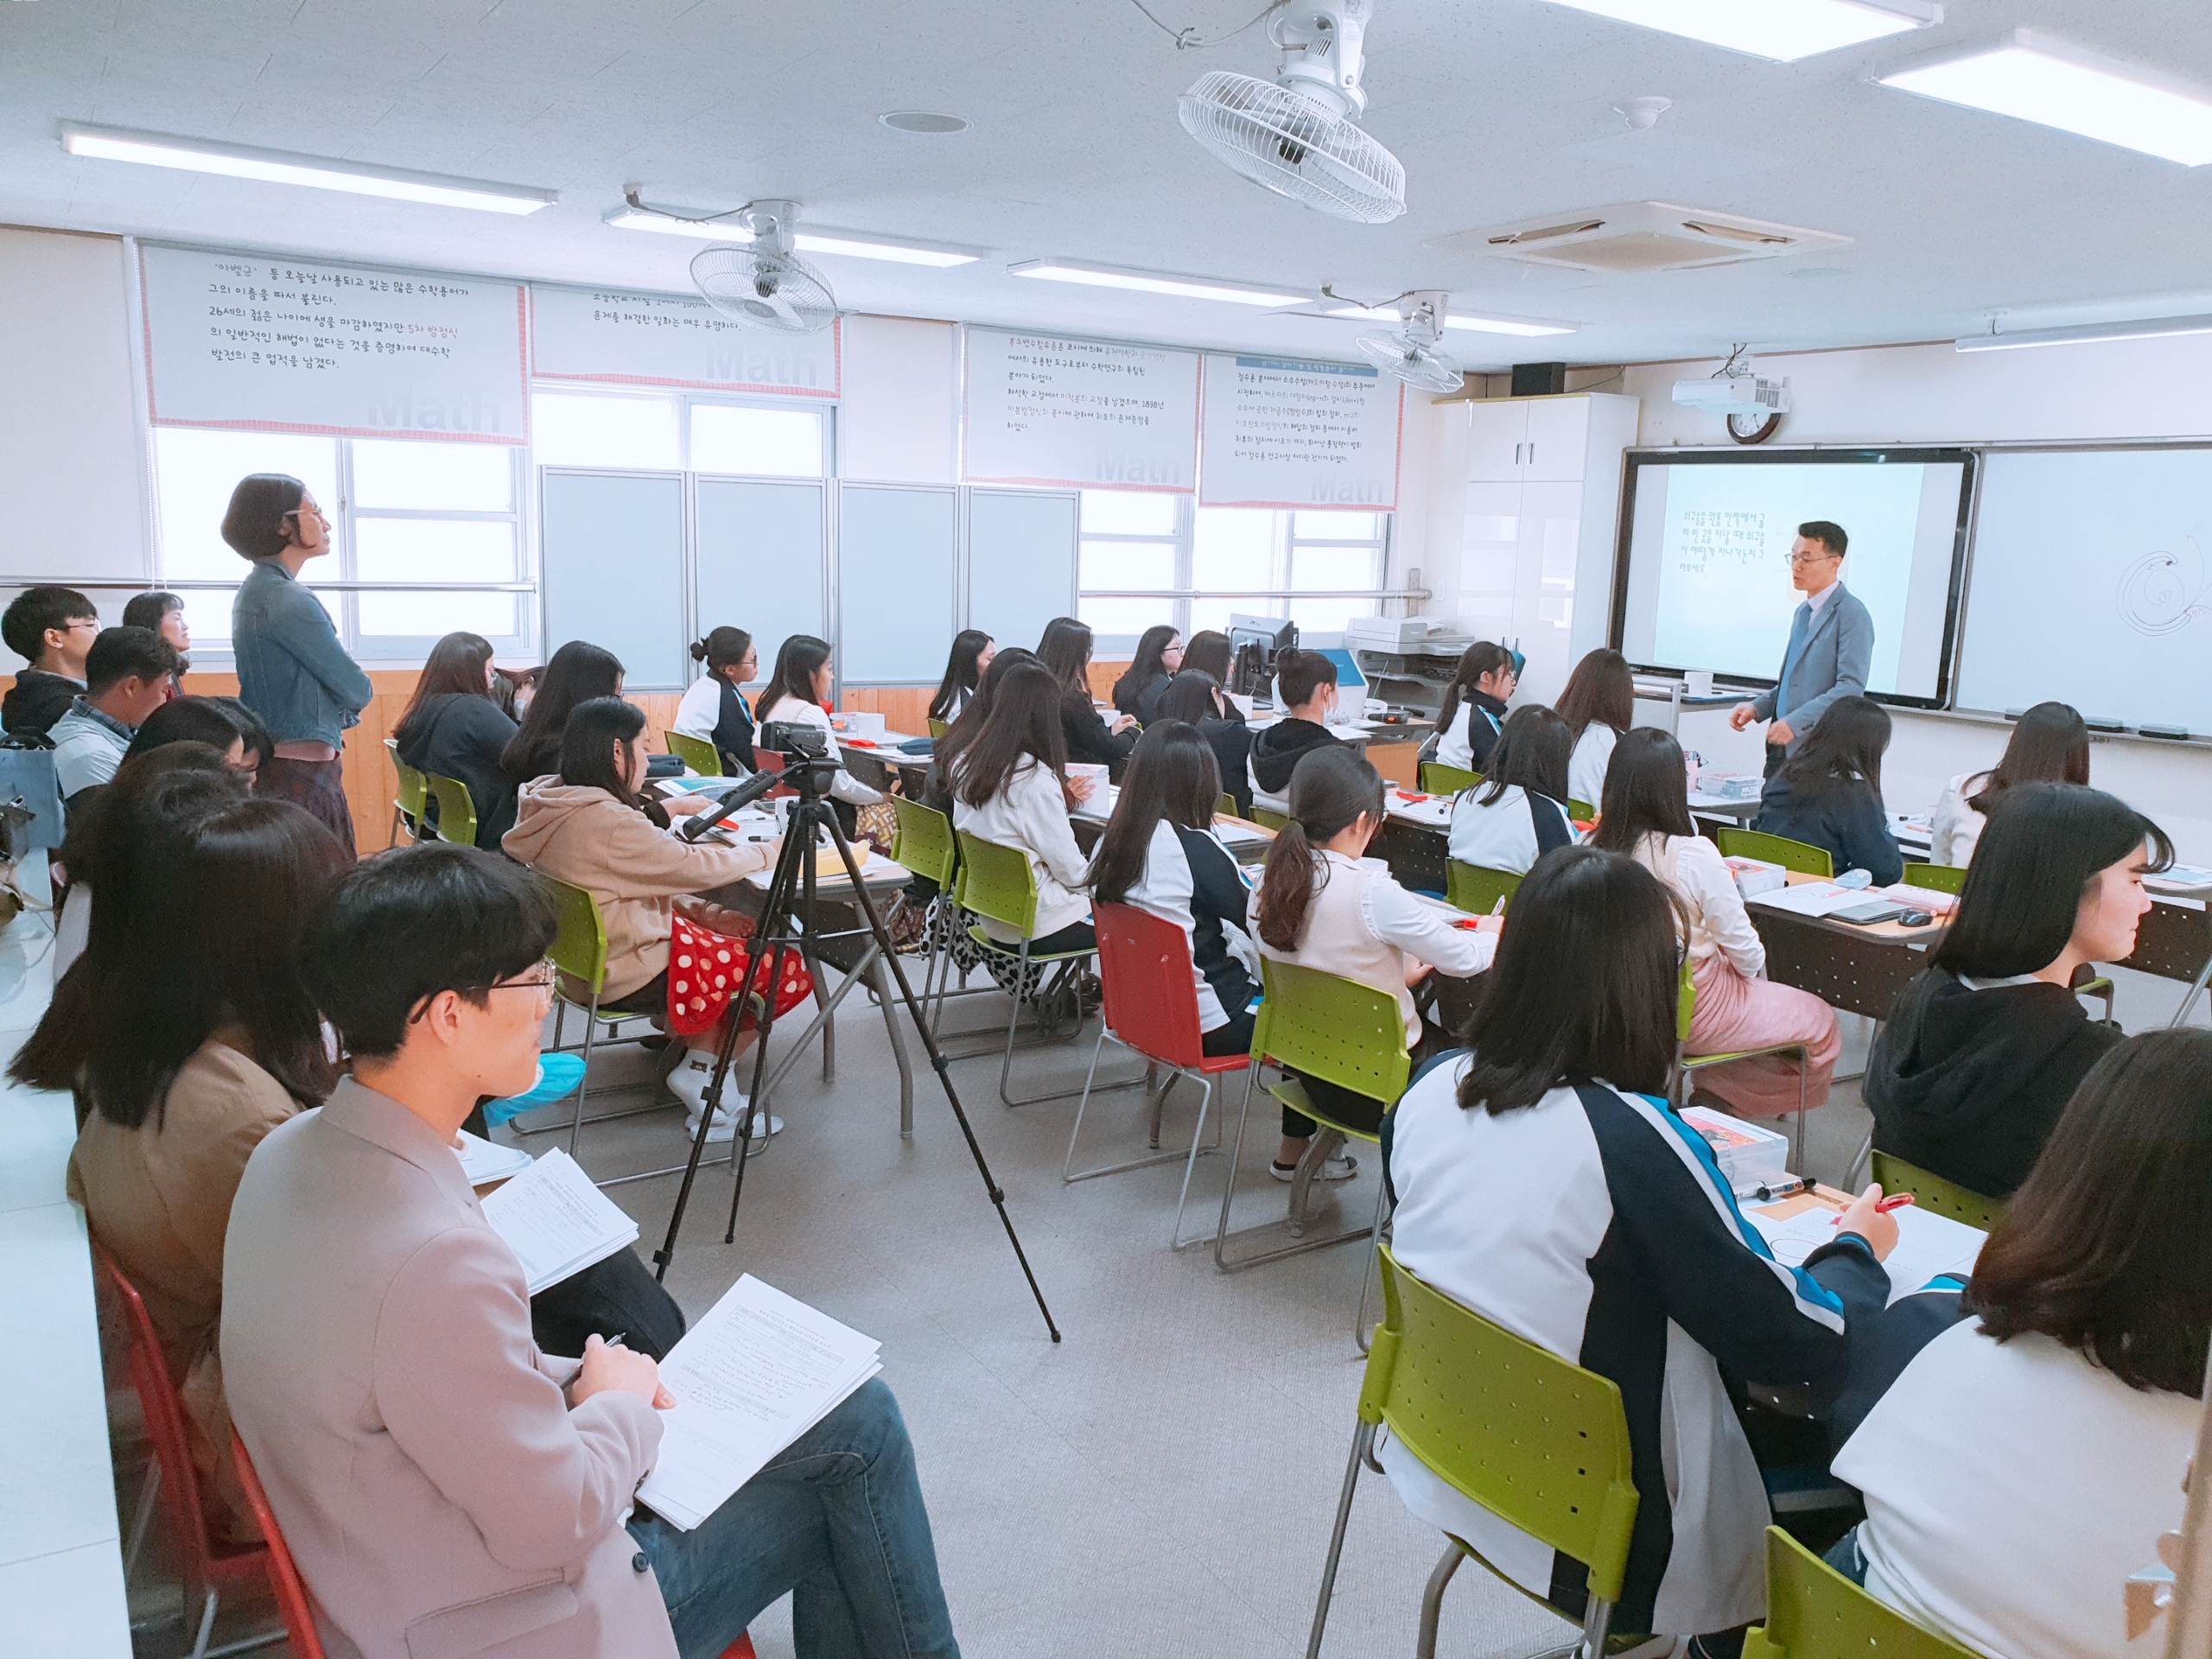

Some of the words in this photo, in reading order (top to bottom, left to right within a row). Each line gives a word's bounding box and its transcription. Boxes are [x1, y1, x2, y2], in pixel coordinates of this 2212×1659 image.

[270, 269, 279, 280] 등
[285, 270, 317, 284] 오늘날
[321, 275, 364, 287] 사용되고
[369, 280, 389, 291] 있는
[394, 282, 413, 294] 많은
[418, 284, 468, 297] 수학용어가
[208, 284, 230, 294] 그의
[236, 288, 269, 301] 이름을
[301, 293, 336, 305] 불린다.
[209, 306, 245, 316] 26세의
[250, 309, 272, 322] 젊은
[277, 314, 310, 322] 나이에
[315, 315, 335, 328] 생을
[340, 319, 404, 334] 마감하였지만
[408, 324, 423, 334] 5차
[428, 327, 457, 339] 방정식
[594, 310, 620, 323] 문제를
[624, 313, 651, 324] 해결한
[654, 316, 680, 327] 일화는
[683, 319, 700, 328] 매우
[704, 321, 741, 331] 유명하다.
[211, 327, 220, 336] 의
[226, 329, 270, 343] 일반적인
[276, 333, 308, 346] 해법이
[314, 337, 345, 349] 없다는
[350, 340, 370, 352] 것을
[375, 341, 416, 354] 증명하여
[420, 346, 450, 359] 대수학
[212, 349, 245, 361] 발전의
[251, 352, 261, 364] 큰
[266, 353, 298, 367] 업적을
[303, 357, 339, 369] 남겼다.
[706, 340, 817, 386] Math
[1032, 357, 1052, 366] 유용한
[1055, 359, 1088, 369] 도구로부터
[1091, 363, 1123, 372] 수학연구의
[1127, 366, 1145, 376] 독립된
[1008, 372, 1028, 380] 분야가
[1032, 373, 1053, 384] 되었다.
[1238, 372, 1255, 383] 정수론
[367, 384, 500, 432] Math
[1008, 388, 1028, 398] 해석학
[1061, 393, 1087, 403] 미적분의
[1142, 400, 1164, 410] 1838년
[1007, 406, 1048, 416] 미분방정식의
[1074, 410, 1093, 419] 관하여
[1257, 405, 1268, 414] 관한
[1310, 424, 1320, 433] 정리
[1323, 424, 1339, 433] 등에서
[1255, 436, 1273, 445] 정리에
[1096, 447, 1180, 483] Math
[1249, 451, 1265, 461] 정수론
[1311, 471, 1382, 502] Math
[1725, 512, 1756, 527] 안쪽에서
[1692, 530, 1698, 543] 빈
[1715, 530, 1730, 544] 지날
[1733, 531, 1744, 539] 때
[1681, 546, 1688, 555] 이
[1759, 550, 1764, 558] 그
